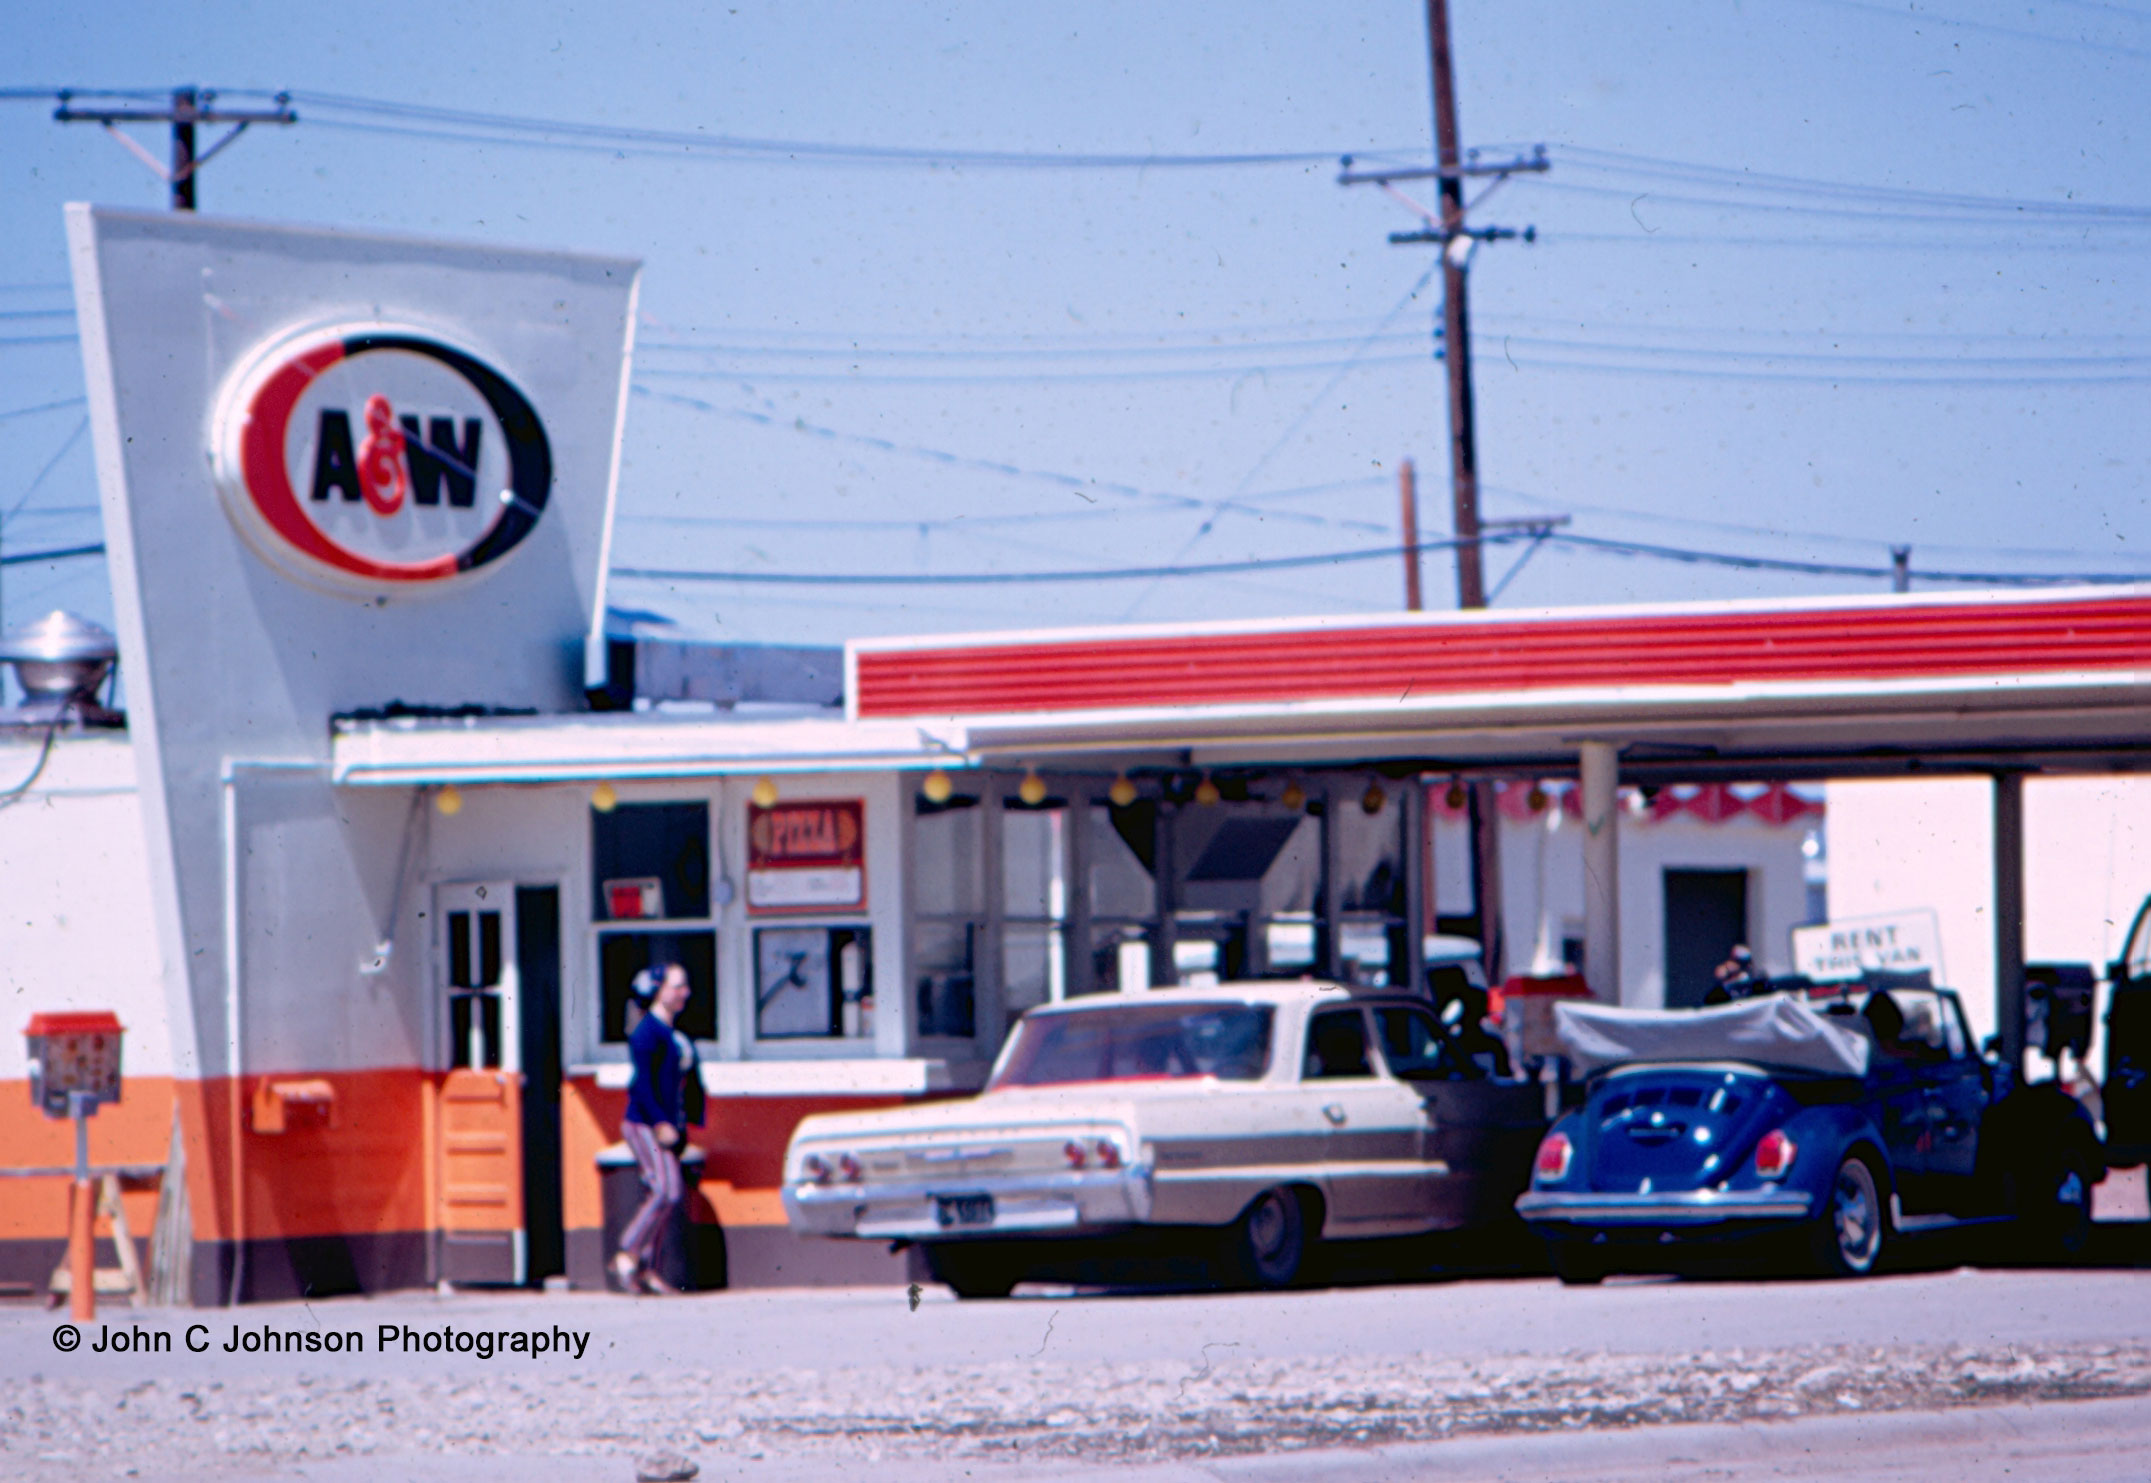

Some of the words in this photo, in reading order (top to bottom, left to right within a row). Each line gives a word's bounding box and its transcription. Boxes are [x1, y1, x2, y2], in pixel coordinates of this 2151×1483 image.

[312, 393, 482, 518] A&W
[771, 809, 837, 855] PIZZA
[1831, 925, 1897, 950] RENT
[1876, 947, 1921, 964] VAN
